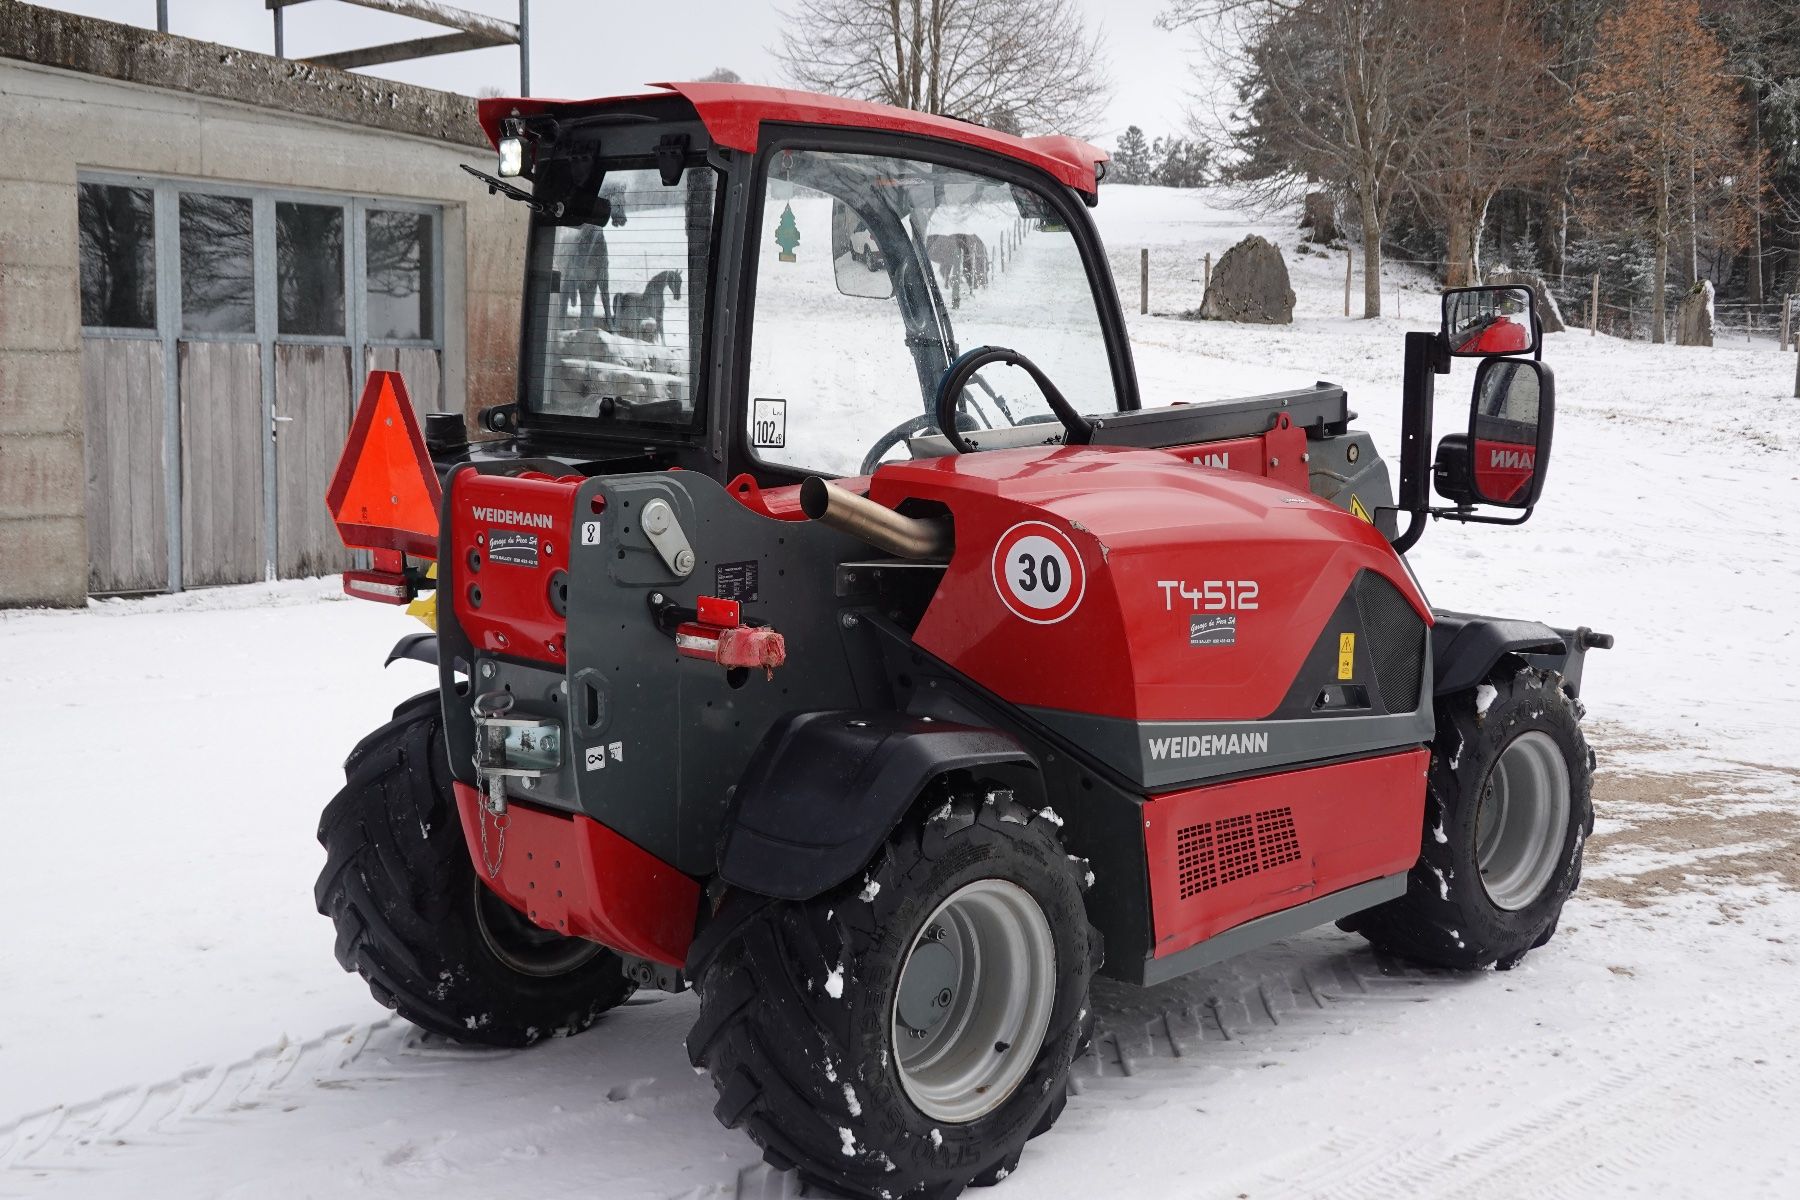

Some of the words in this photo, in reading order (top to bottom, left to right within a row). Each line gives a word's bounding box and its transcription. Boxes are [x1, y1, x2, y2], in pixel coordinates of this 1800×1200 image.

[757, 420, 775, 444] 102
[472, 506, 553, 529] WEIDEMANN
[1018, 553, 1062, 593] 30
[1157, 580, 1260, 611] T4512
[1148, 732, 1269, 760] WEIDEMANN
